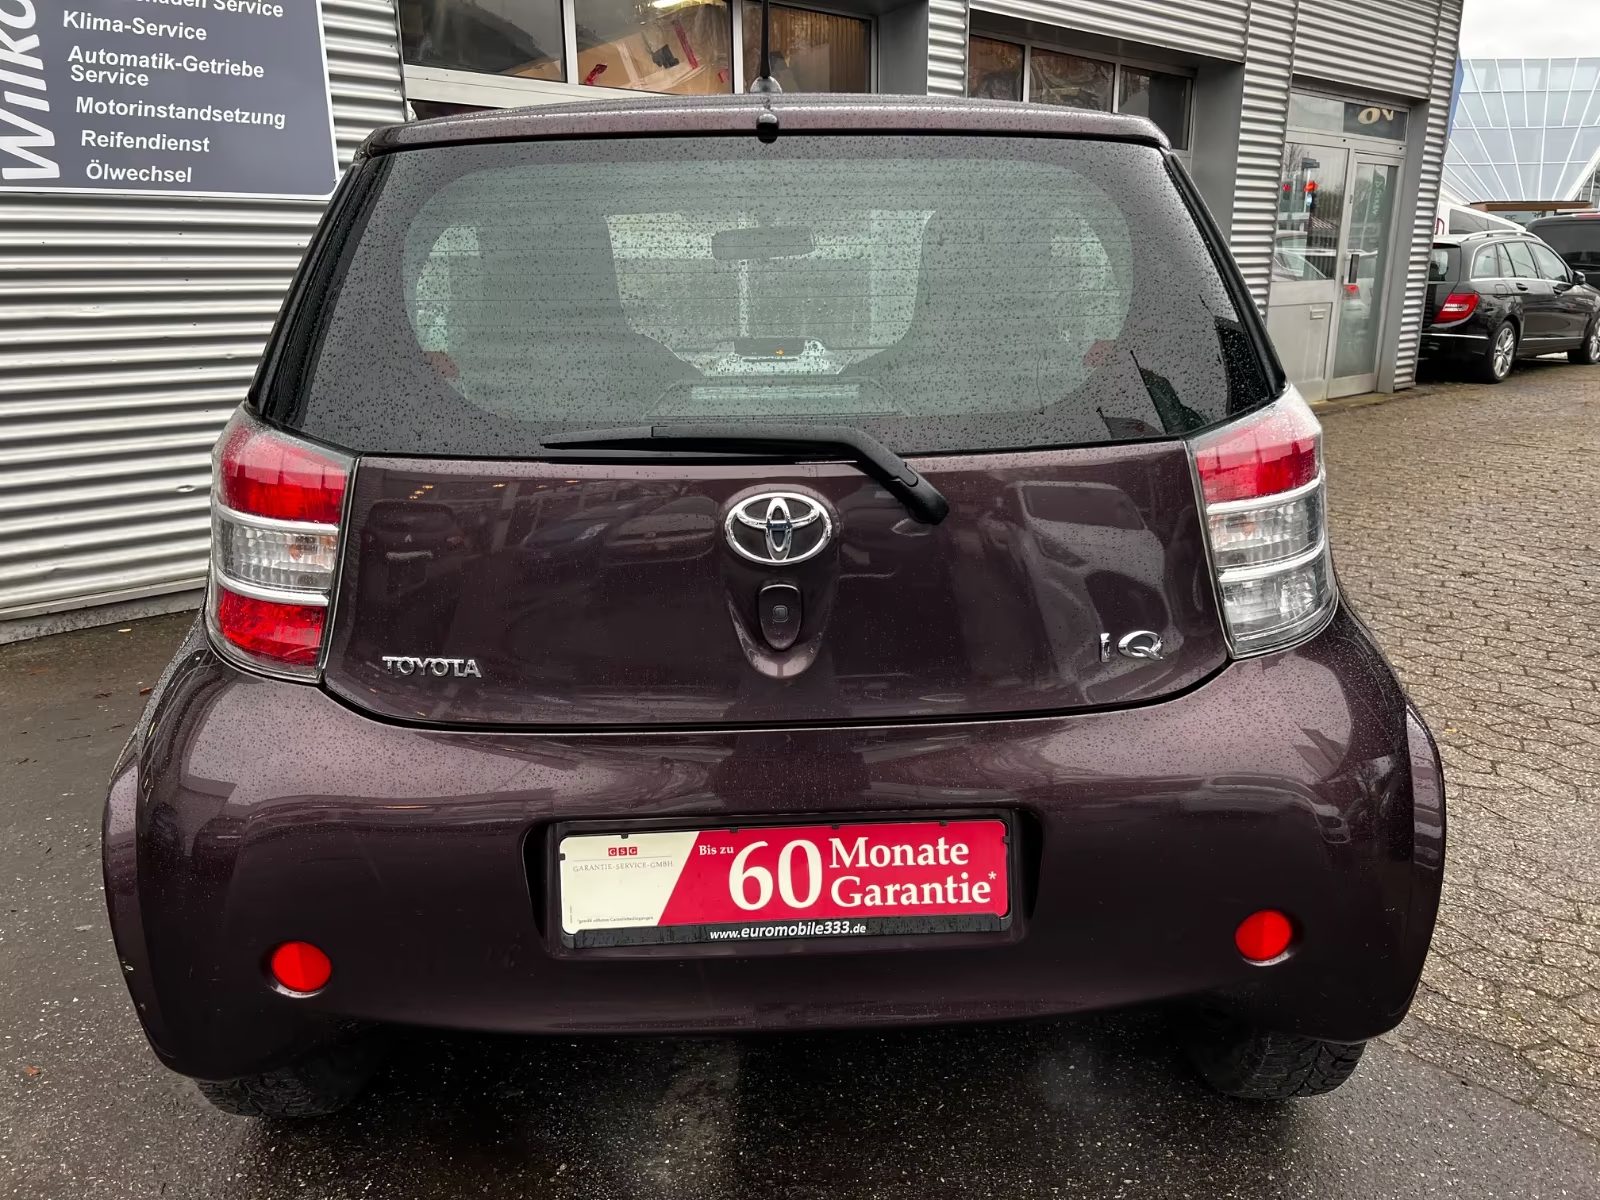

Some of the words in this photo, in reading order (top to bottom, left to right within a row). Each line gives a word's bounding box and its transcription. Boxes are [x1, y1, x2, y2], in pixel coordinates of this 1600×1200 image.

[213, 0, 284, 18] Service
[62, 10, 208, 41] Klima-Service
[67, 45, 265, 78] Automatik-Getriebe
[70, 64, 150, 87] Service
[75, 96, 286, 130] Motorinstandsetzung
[80, 129, 210, 153] Reifendienst
[86, 159, 192, 184] Ölwechsel
[382, 656, 482, 678] TOYOTA
[698, 844, 717, 856] Bis
[719, 846, 734, 854] zu
[828, 836, 970, 869] Monate
[728, 839, 823, 911] 60
[709, 921, 867, 940] www.euromobile333.de
